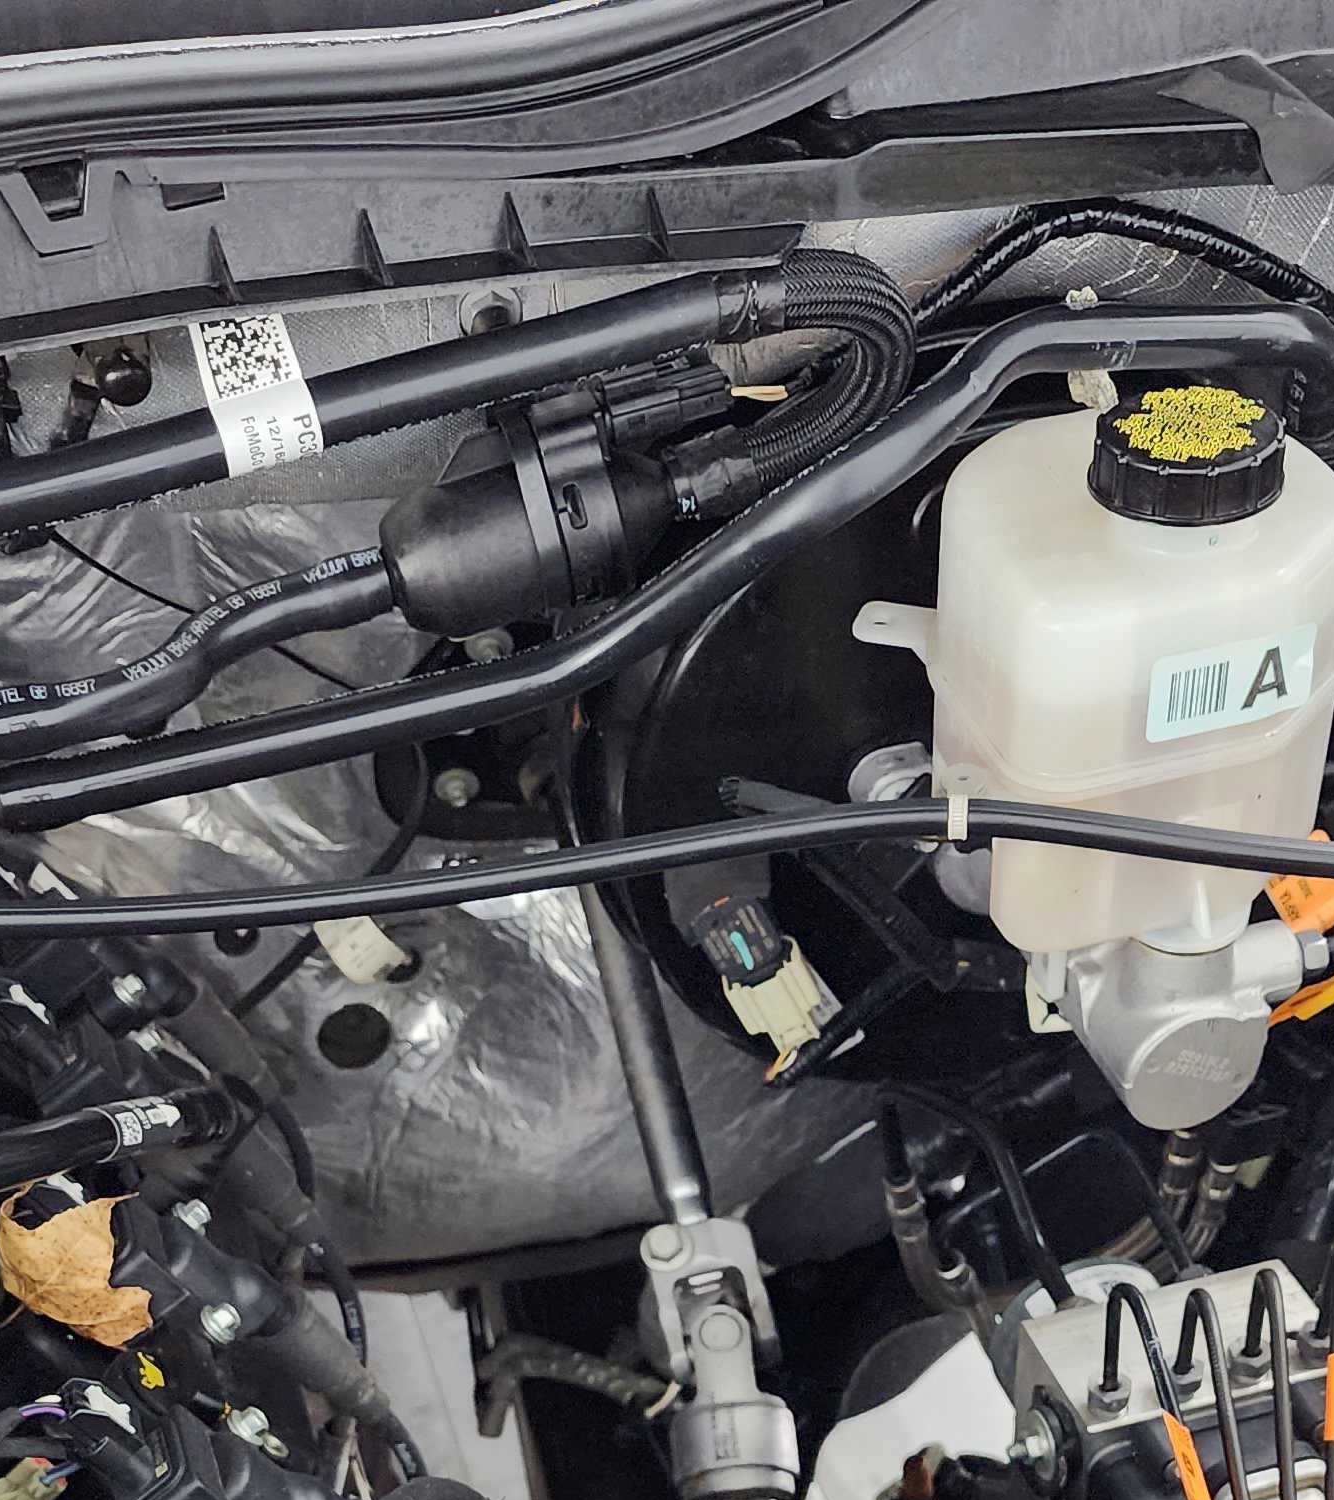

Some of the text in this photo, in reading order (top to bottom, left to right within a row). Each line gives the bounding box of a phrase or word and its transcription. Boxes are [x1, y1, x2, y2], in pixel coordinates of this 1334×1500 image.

[240, 416, 266, 467] FoMoCo
[301, 556, 350, 584] VACUUM
[29, 684, 48, 700] GB
[1240, 645, 1288, 711] A
